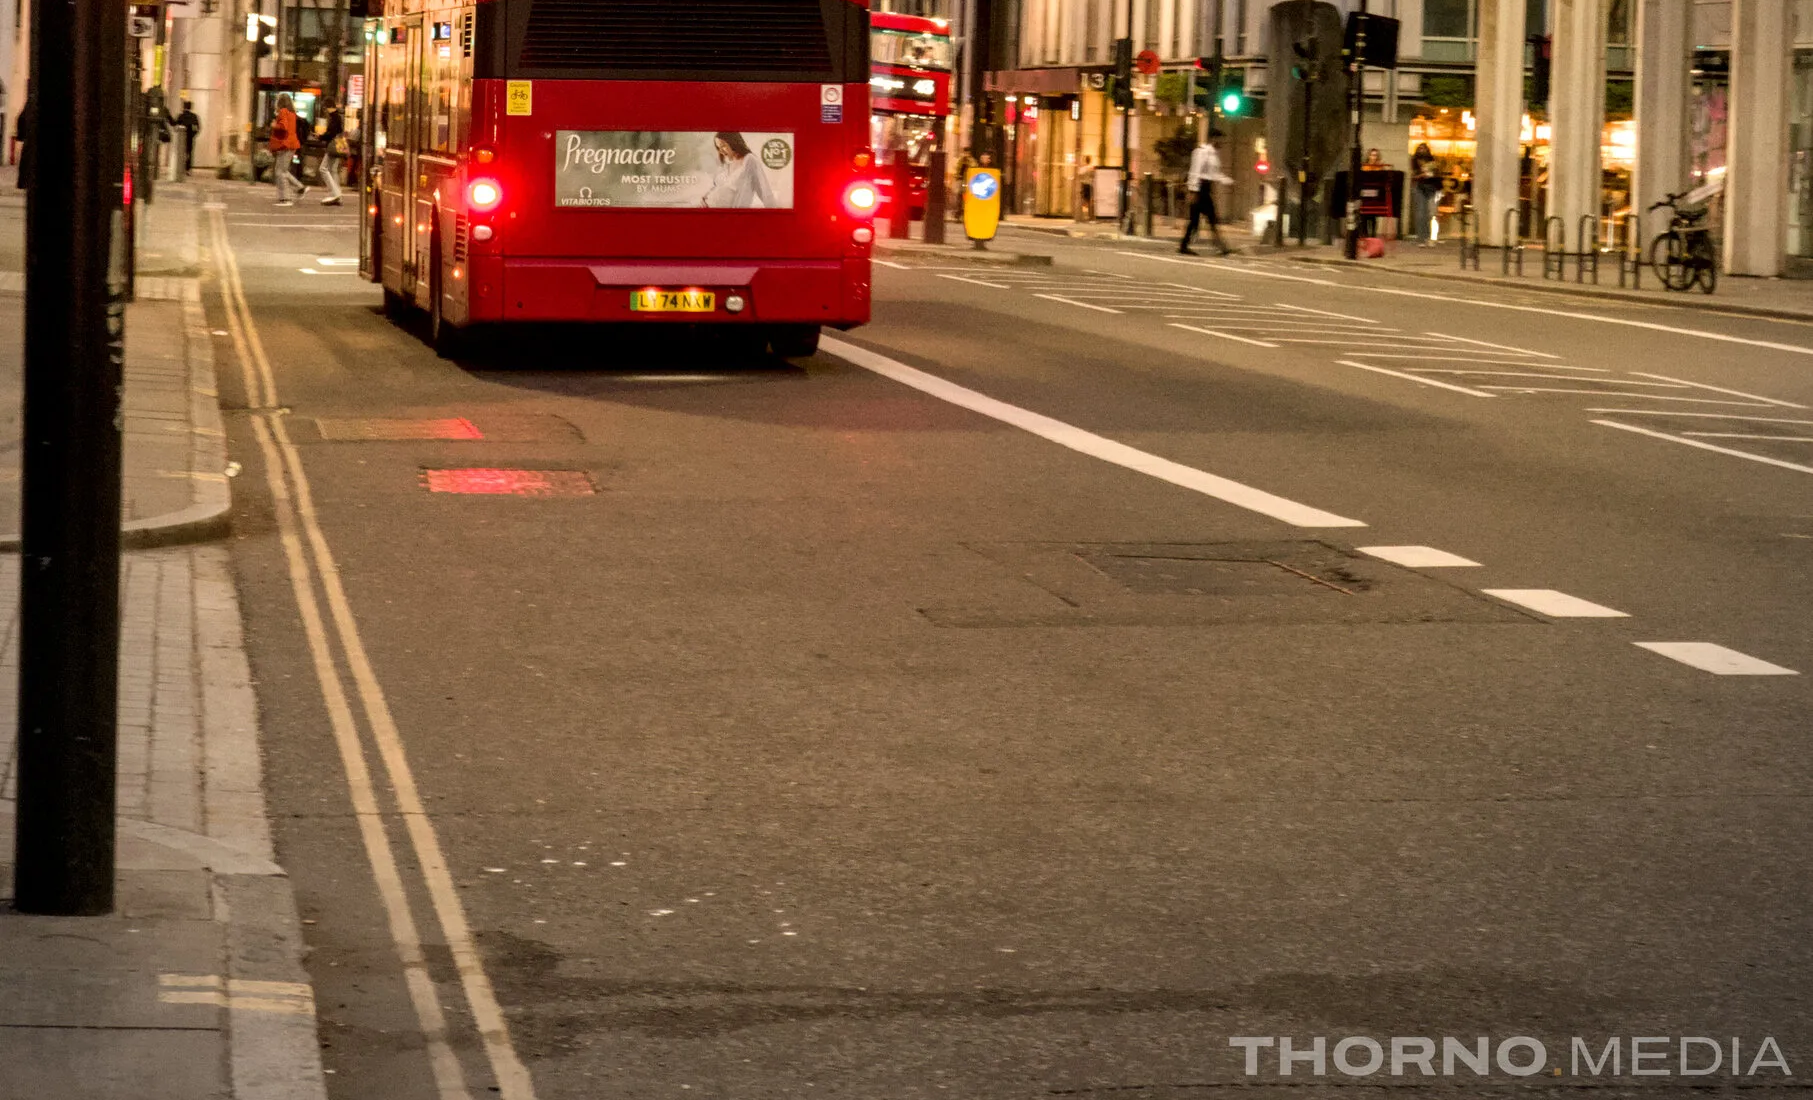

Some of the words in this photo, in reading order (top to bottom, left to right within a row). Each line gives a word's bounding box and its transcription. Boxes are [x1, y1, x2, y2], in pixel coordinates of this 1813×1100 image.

[563, 133, 677, 174] Pregnacare
[621, 175, 652, 184] MOST
[654, 175, 698, 184] TRUSTED
[636, 185, 648, 193] BY
[561, 197, 611, 206] VITABIOTICS
